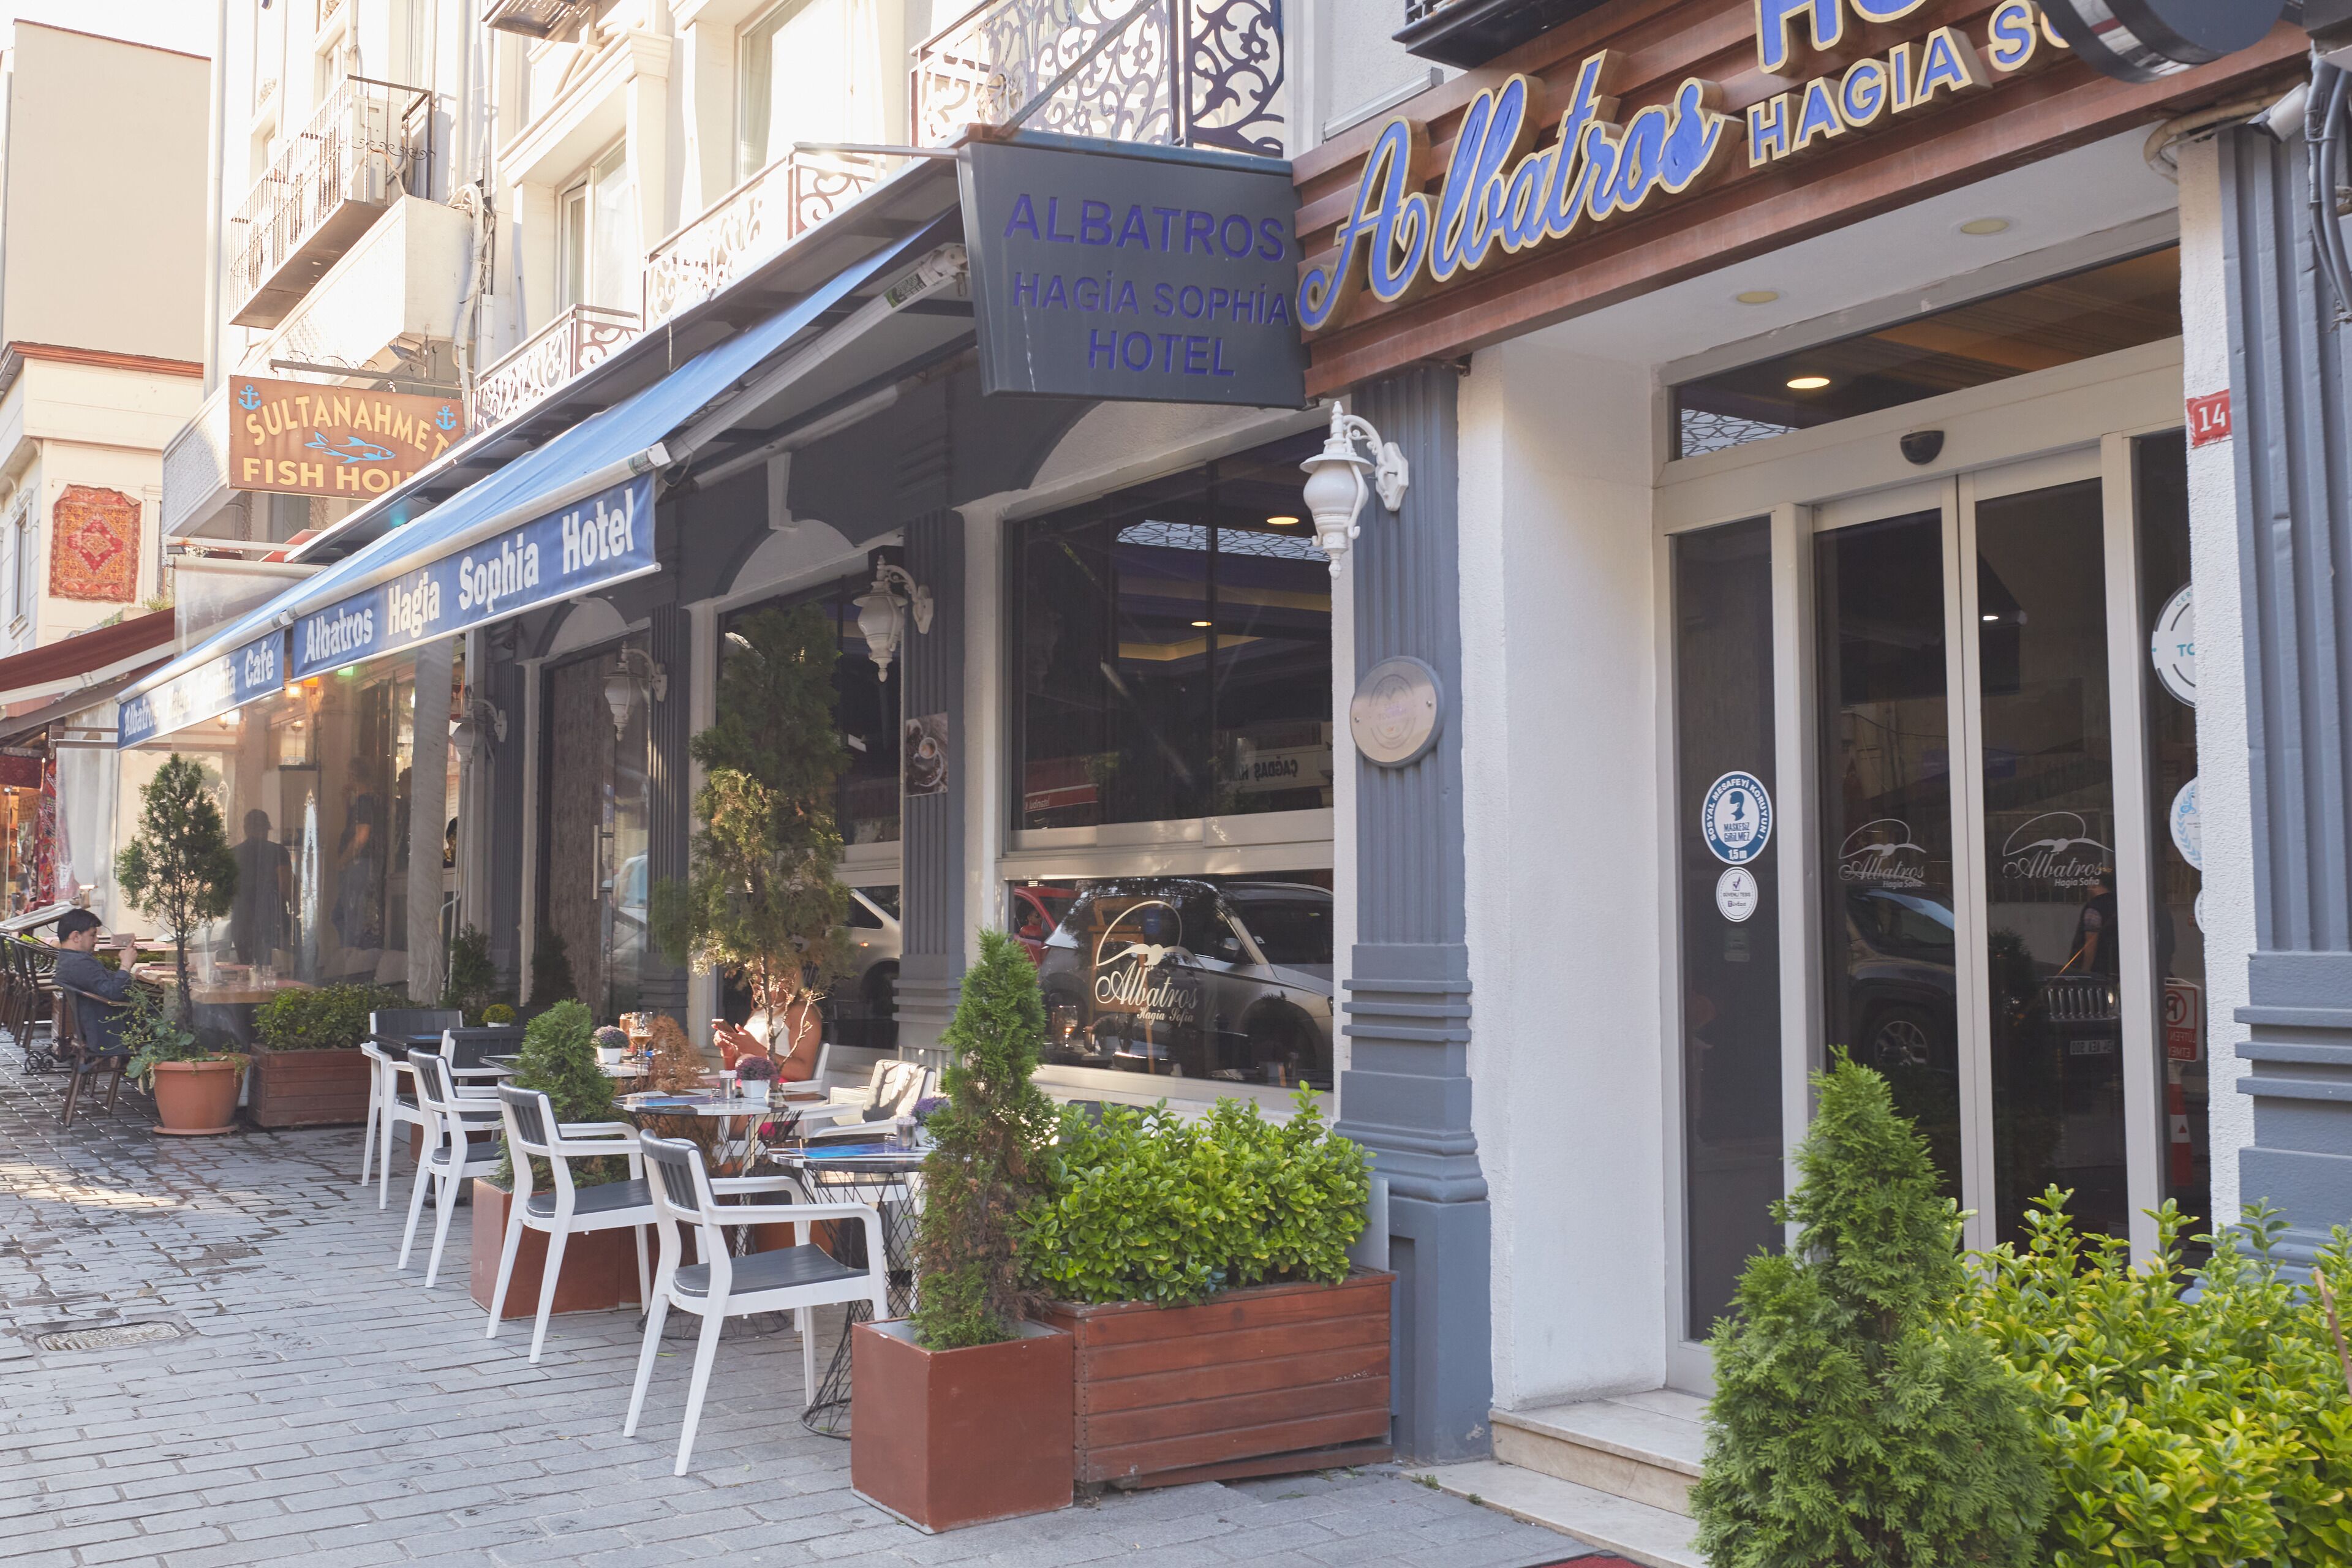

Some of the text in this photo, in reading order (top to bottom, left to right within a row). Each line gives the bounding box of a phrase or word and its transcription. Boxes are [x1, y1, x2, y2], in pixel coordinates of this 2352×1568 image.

[1747, 0, 2070, 168] HAGIA S
[1297, 48, 1726, 331] Albatros
[1003, 194, 1284, 262] ALBATROS
[1013, 271, 1291, 326] HAGİA SOPHİA
[1088, 329, 1235, 377] HOTEL
[246, 394, 450, 461] SULTANAHMET
[2199, 402, 2226, 432] 14
[243, 457, 324, 488] FISH
[304, 488, 635, 665] Albatros Hagia Sophia Hotel
[246, 641, 275, 688] Cafe
[1706, 802, 1716, 841] SOSYAL
[1711, 778, 1750, 801] MESAFEYİ
[1838, 854, 1924, 880] Albatros
[1883, 880, 1904, 889] Hagia
[2003, 850, 2103, 879] Albatros
[2054, 877, 2100, 888] Hagia Sofia
[1095, 960, 1199, 1009] Albatros
[1137, 1006, 1194, 1027] Hagia Sofia
